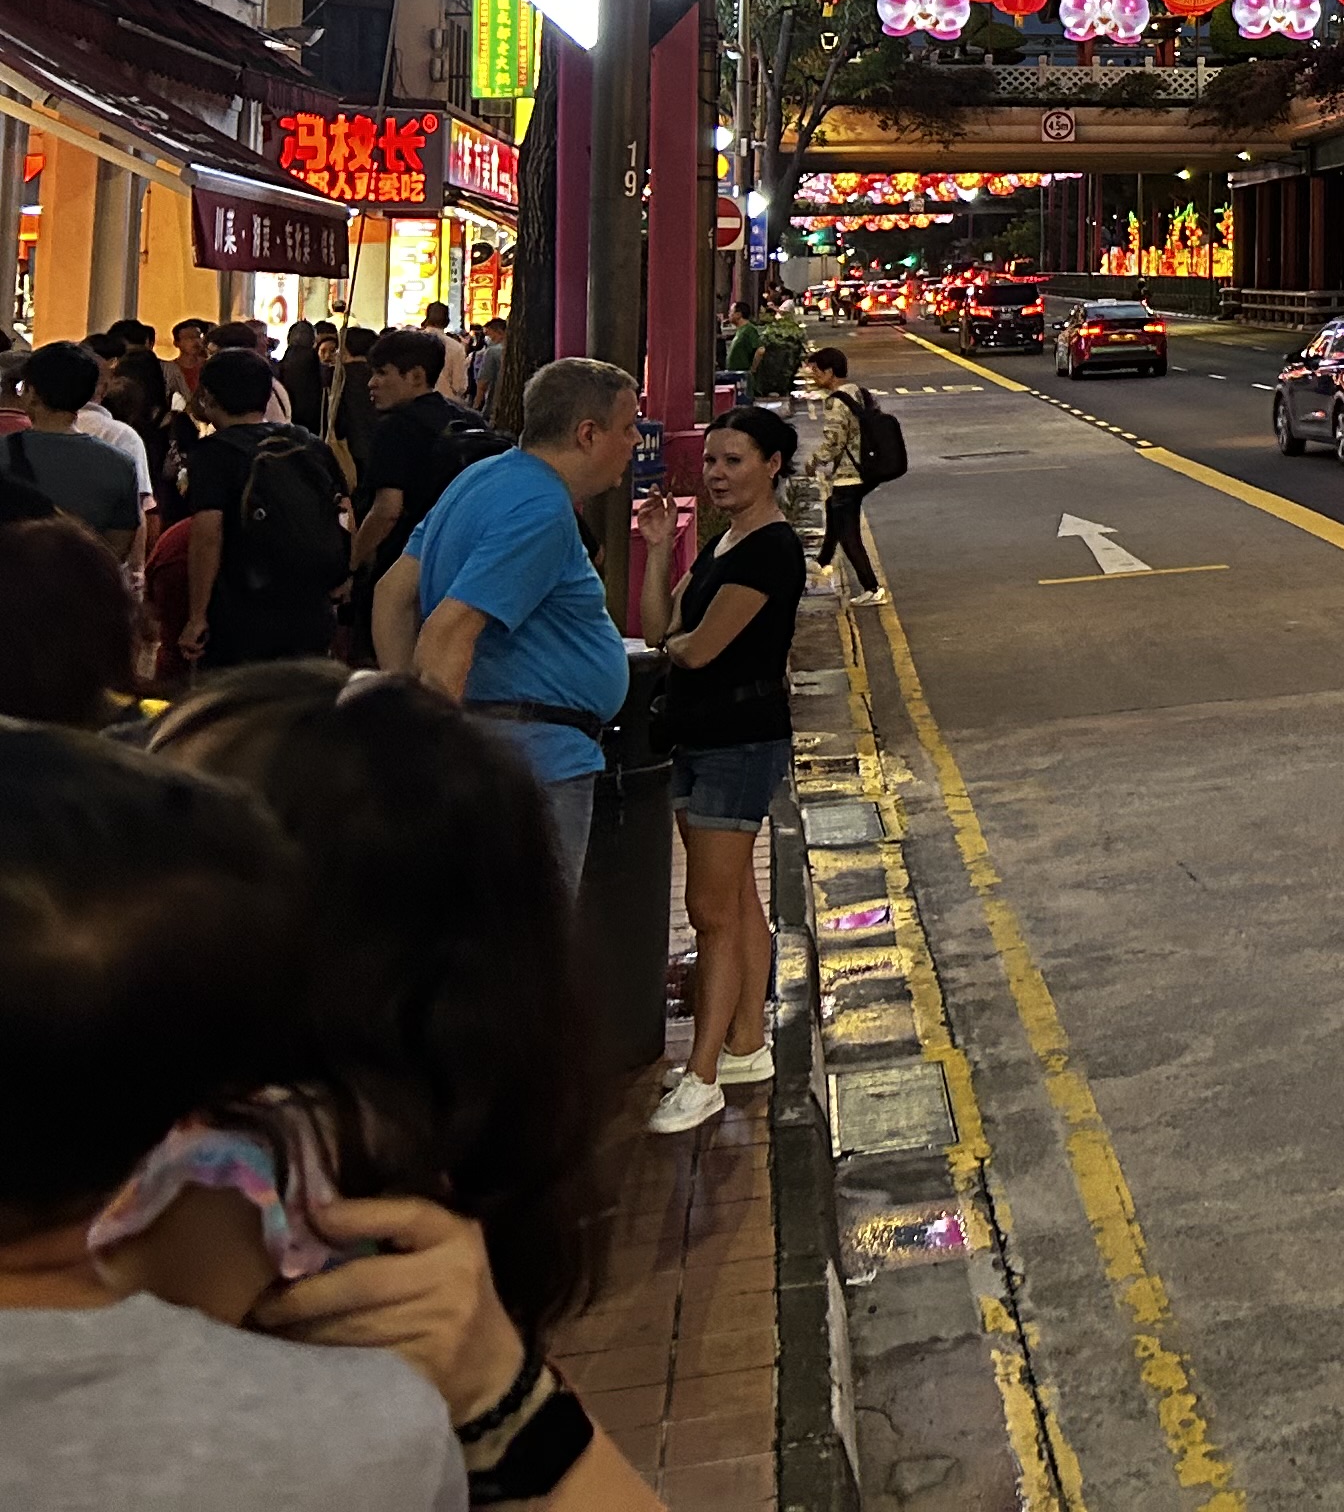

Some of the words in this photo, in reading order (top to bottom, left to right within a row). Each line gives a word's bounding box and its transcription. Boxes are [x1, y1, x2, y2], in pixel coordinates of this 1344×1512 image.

[280, 112, 427, 172] 冯校长
[1048, 120, 1069, 131] 4.5m
